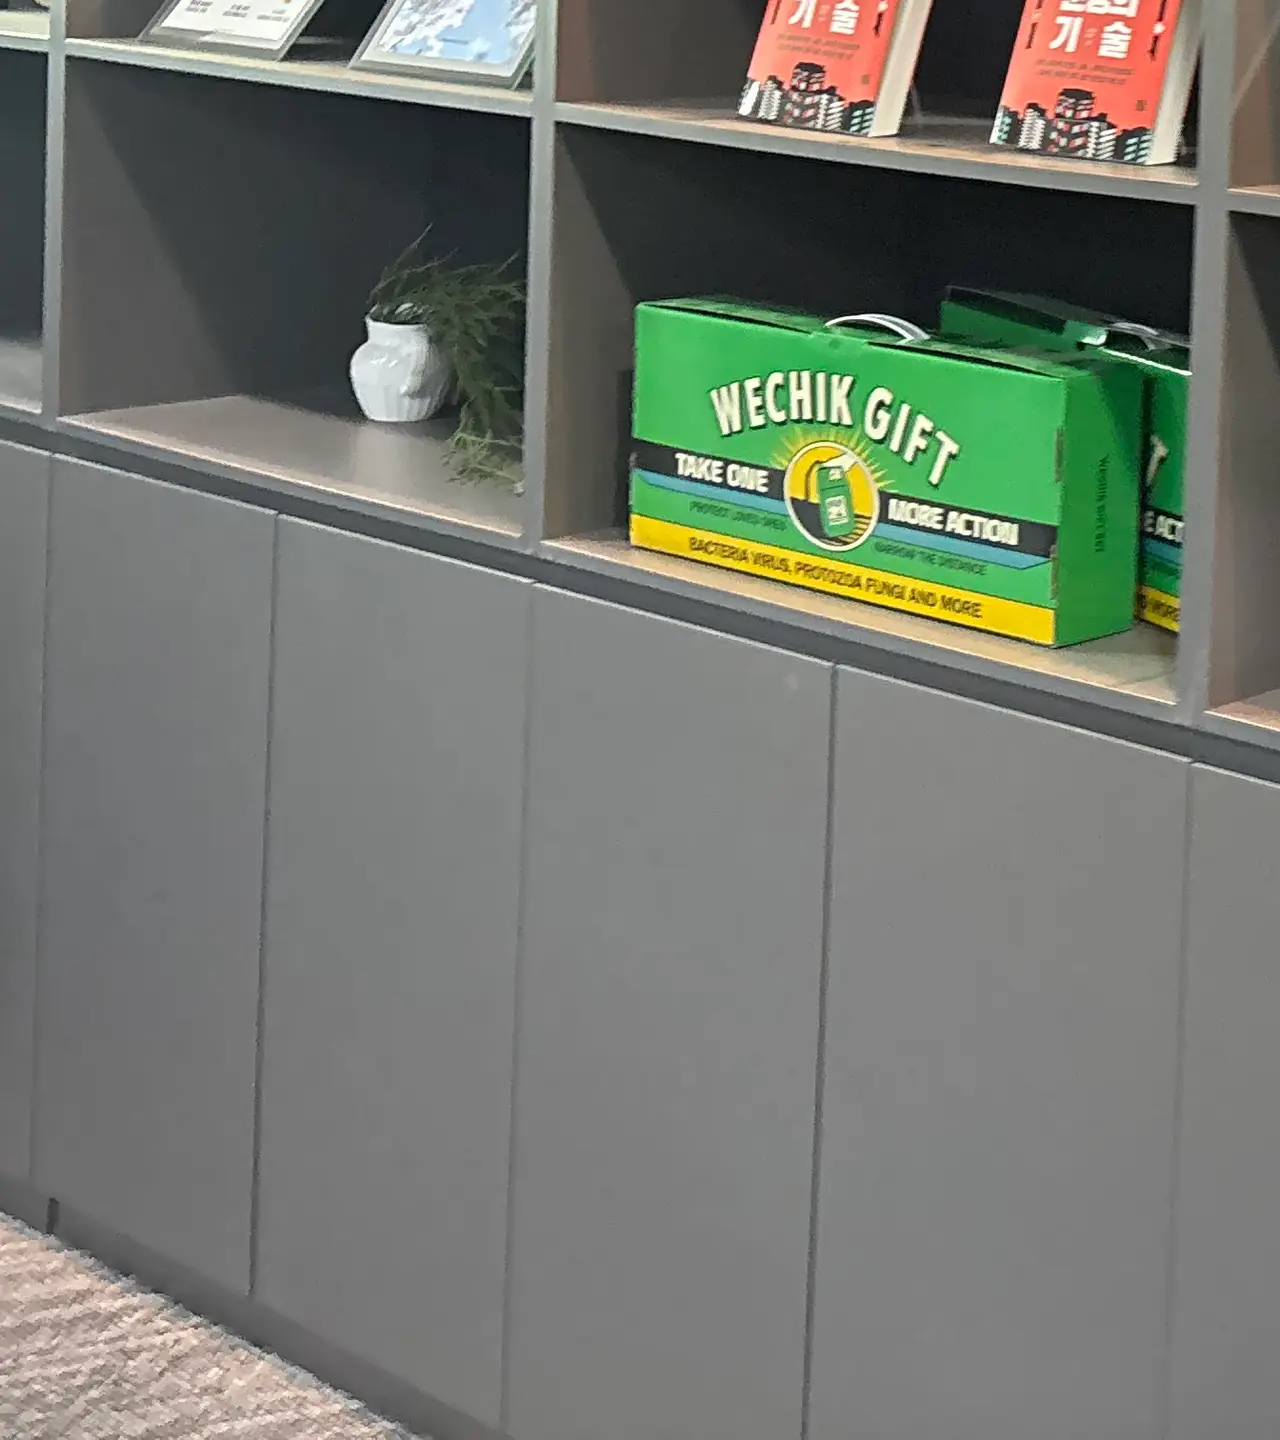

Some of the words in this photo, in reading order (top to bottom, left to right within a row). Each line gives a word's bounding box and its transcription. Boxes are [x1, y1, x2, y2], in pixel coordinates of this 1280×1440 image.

[710, 369, 855, 437] WECHIK
[864, 386, 961, 486] GIFT
[675, 452, 724, 484] TAKE
[726, 463, 769, 493] ONE
[888, 498, 945, 530] MORE
[945, 511, 1020, 546] ACTION
[688, 536, 750, 562] BACTERIA
[865, 577, 907, 601] FUNGI
[908, 587, 938, 608] AND
[940, 594, 984, 619] MORE
